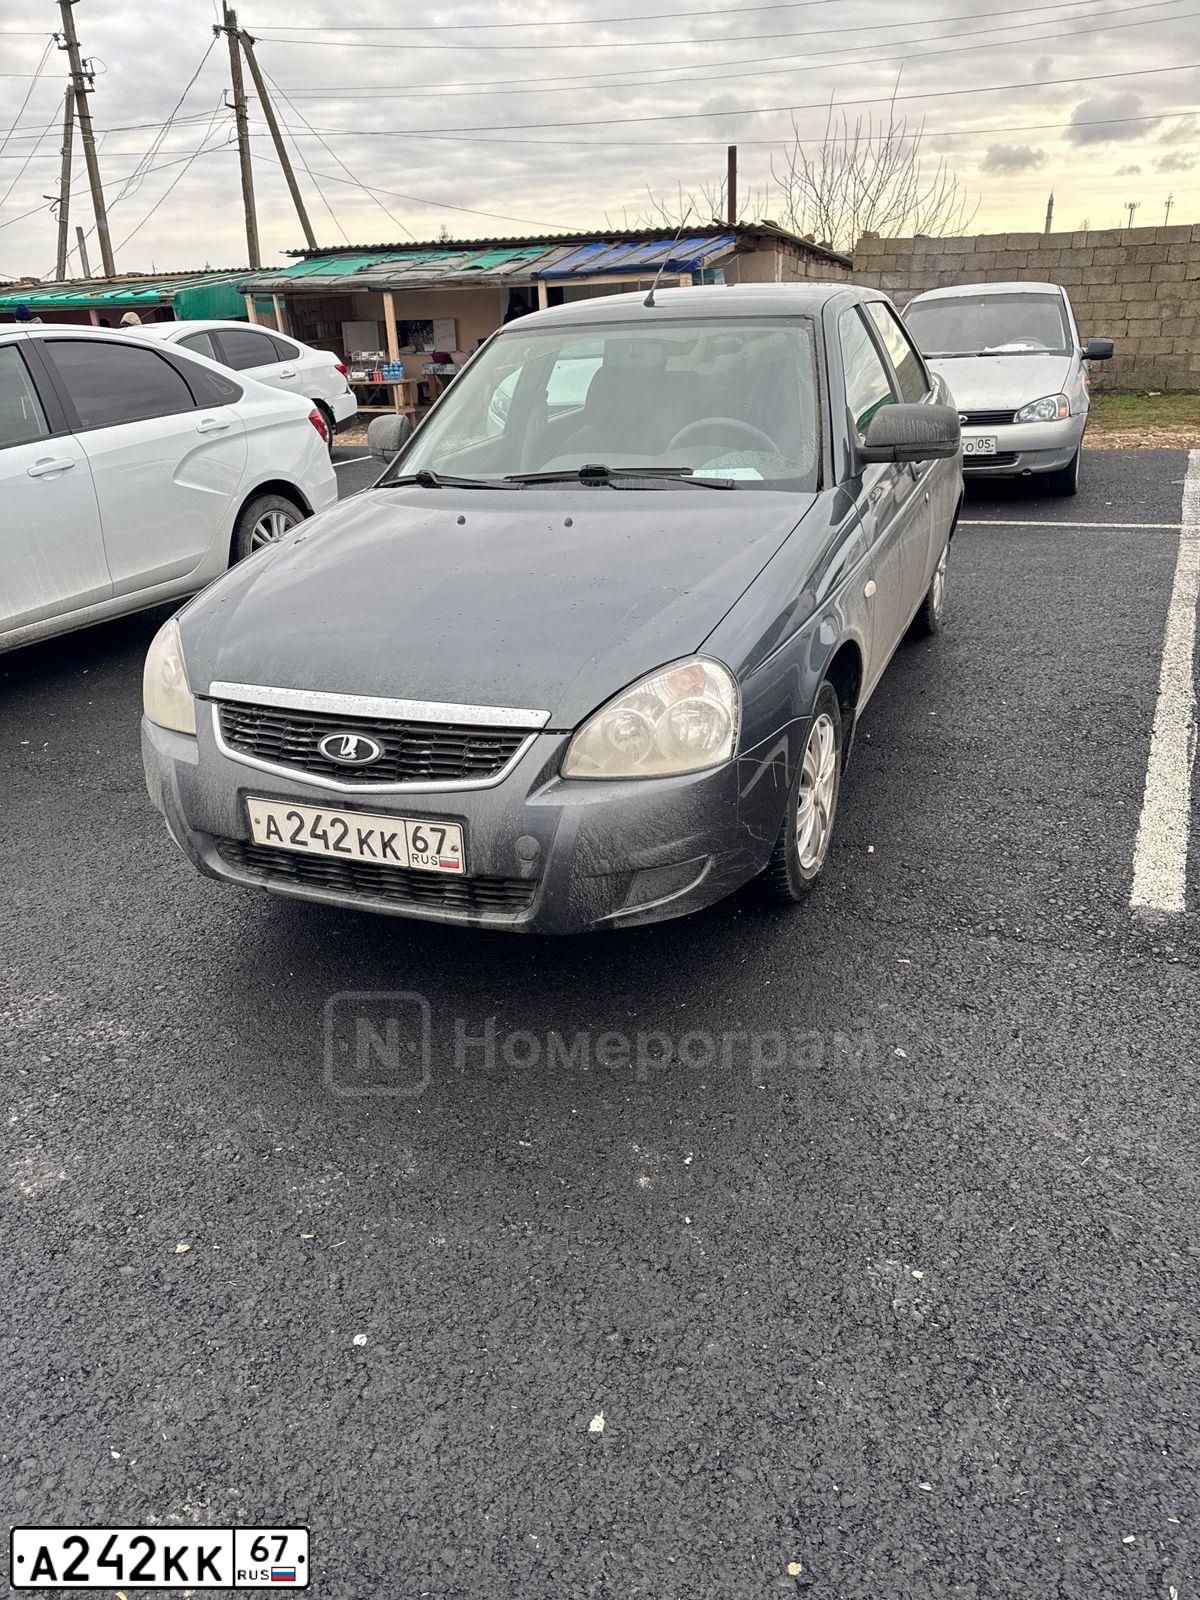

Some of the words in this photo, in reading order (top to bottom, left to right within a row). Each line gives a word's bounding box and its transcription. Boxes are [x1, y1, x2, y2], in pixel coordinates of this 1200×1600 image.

[977, 439, 991, 449] 05
[265, 810, 401, 861] А242КК
[411, 825, 446, 855] 67
[411, 853, 439, 866] RUS
